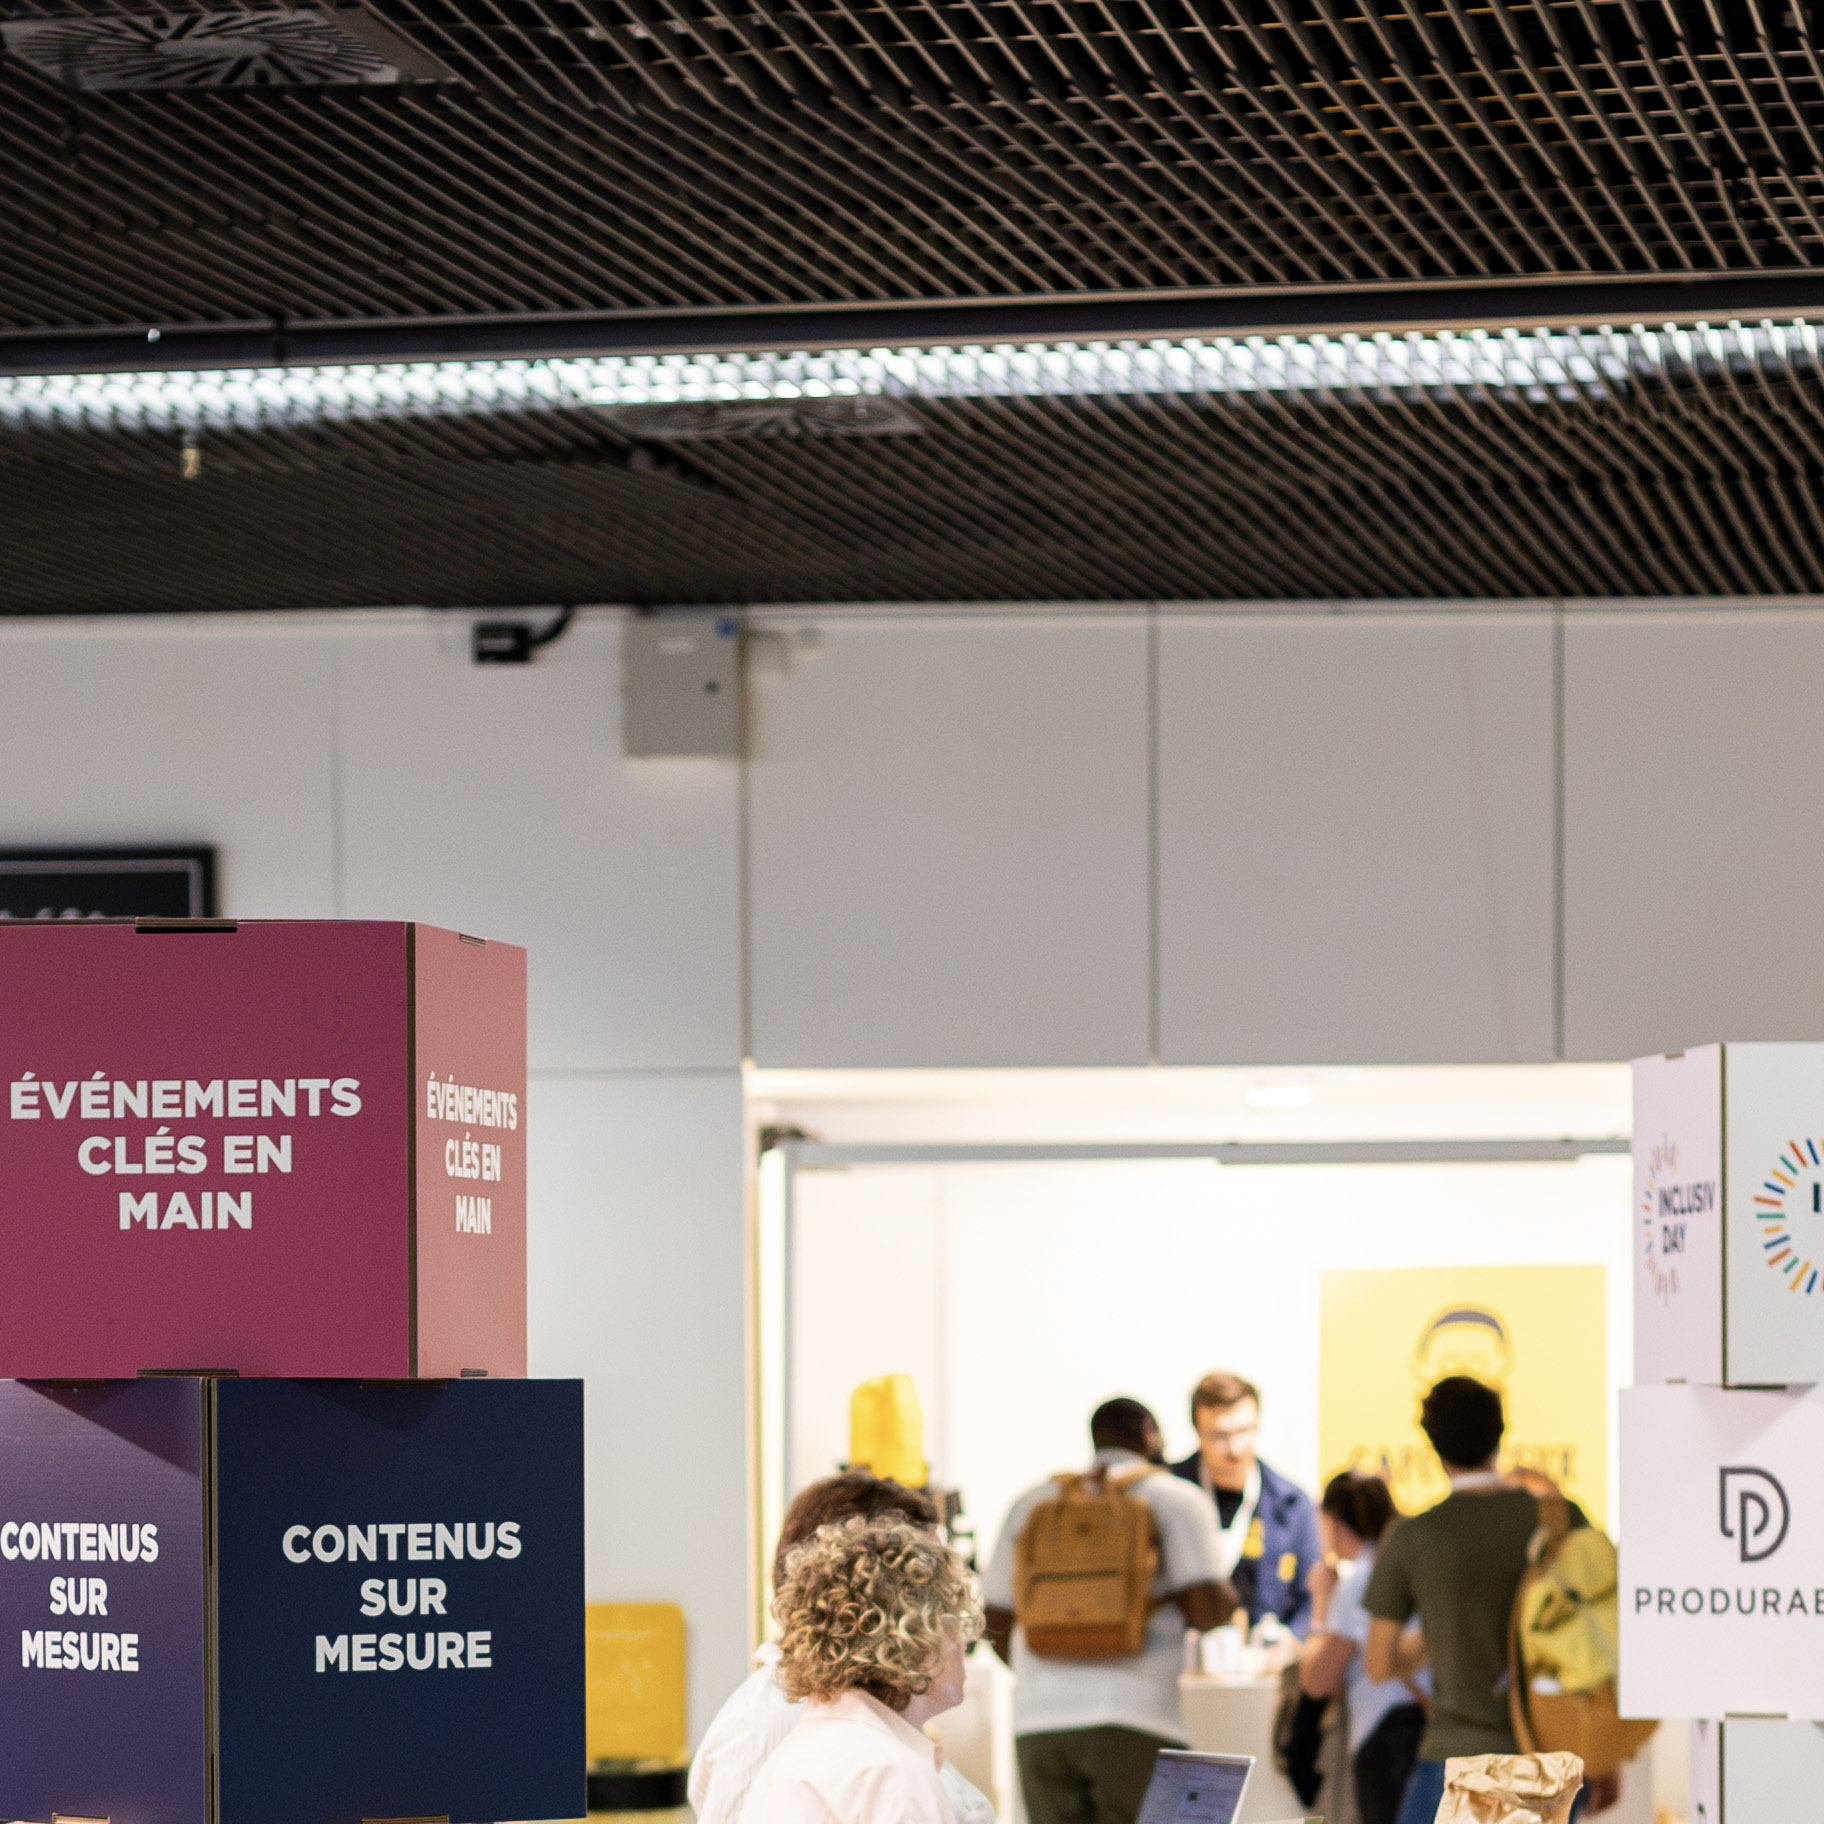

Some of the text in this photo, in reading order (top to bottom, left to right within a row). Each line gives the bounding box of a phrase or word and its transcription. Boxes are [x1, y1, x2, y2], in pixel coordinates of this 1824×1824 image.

[11, 1071, 362, 1120] ÉVÉNEMENTS
[426, 1072, 518, 1130] ÉVÉNEMENTS
[77, 1126, 292, 1175] CLÉS EN
[444, 1131, 501, 1182] CLÉS EN
[119, 1191, 252, 1230] MAIN
[455, 1194, 492, 1234] MAIN
[1662, 1223, 1687, 1256] DAY
[0, 1521, 159, 1563] CONTENUS
[282, 1521, 522, 1564] CONTENUS
[49, 1577, 108, 1616] SUR
[359, 1577, 448, 1617] SUR
[21, 1630, 139, 1672] MESURE
[315, 1630, 492, 1673] MESURE
